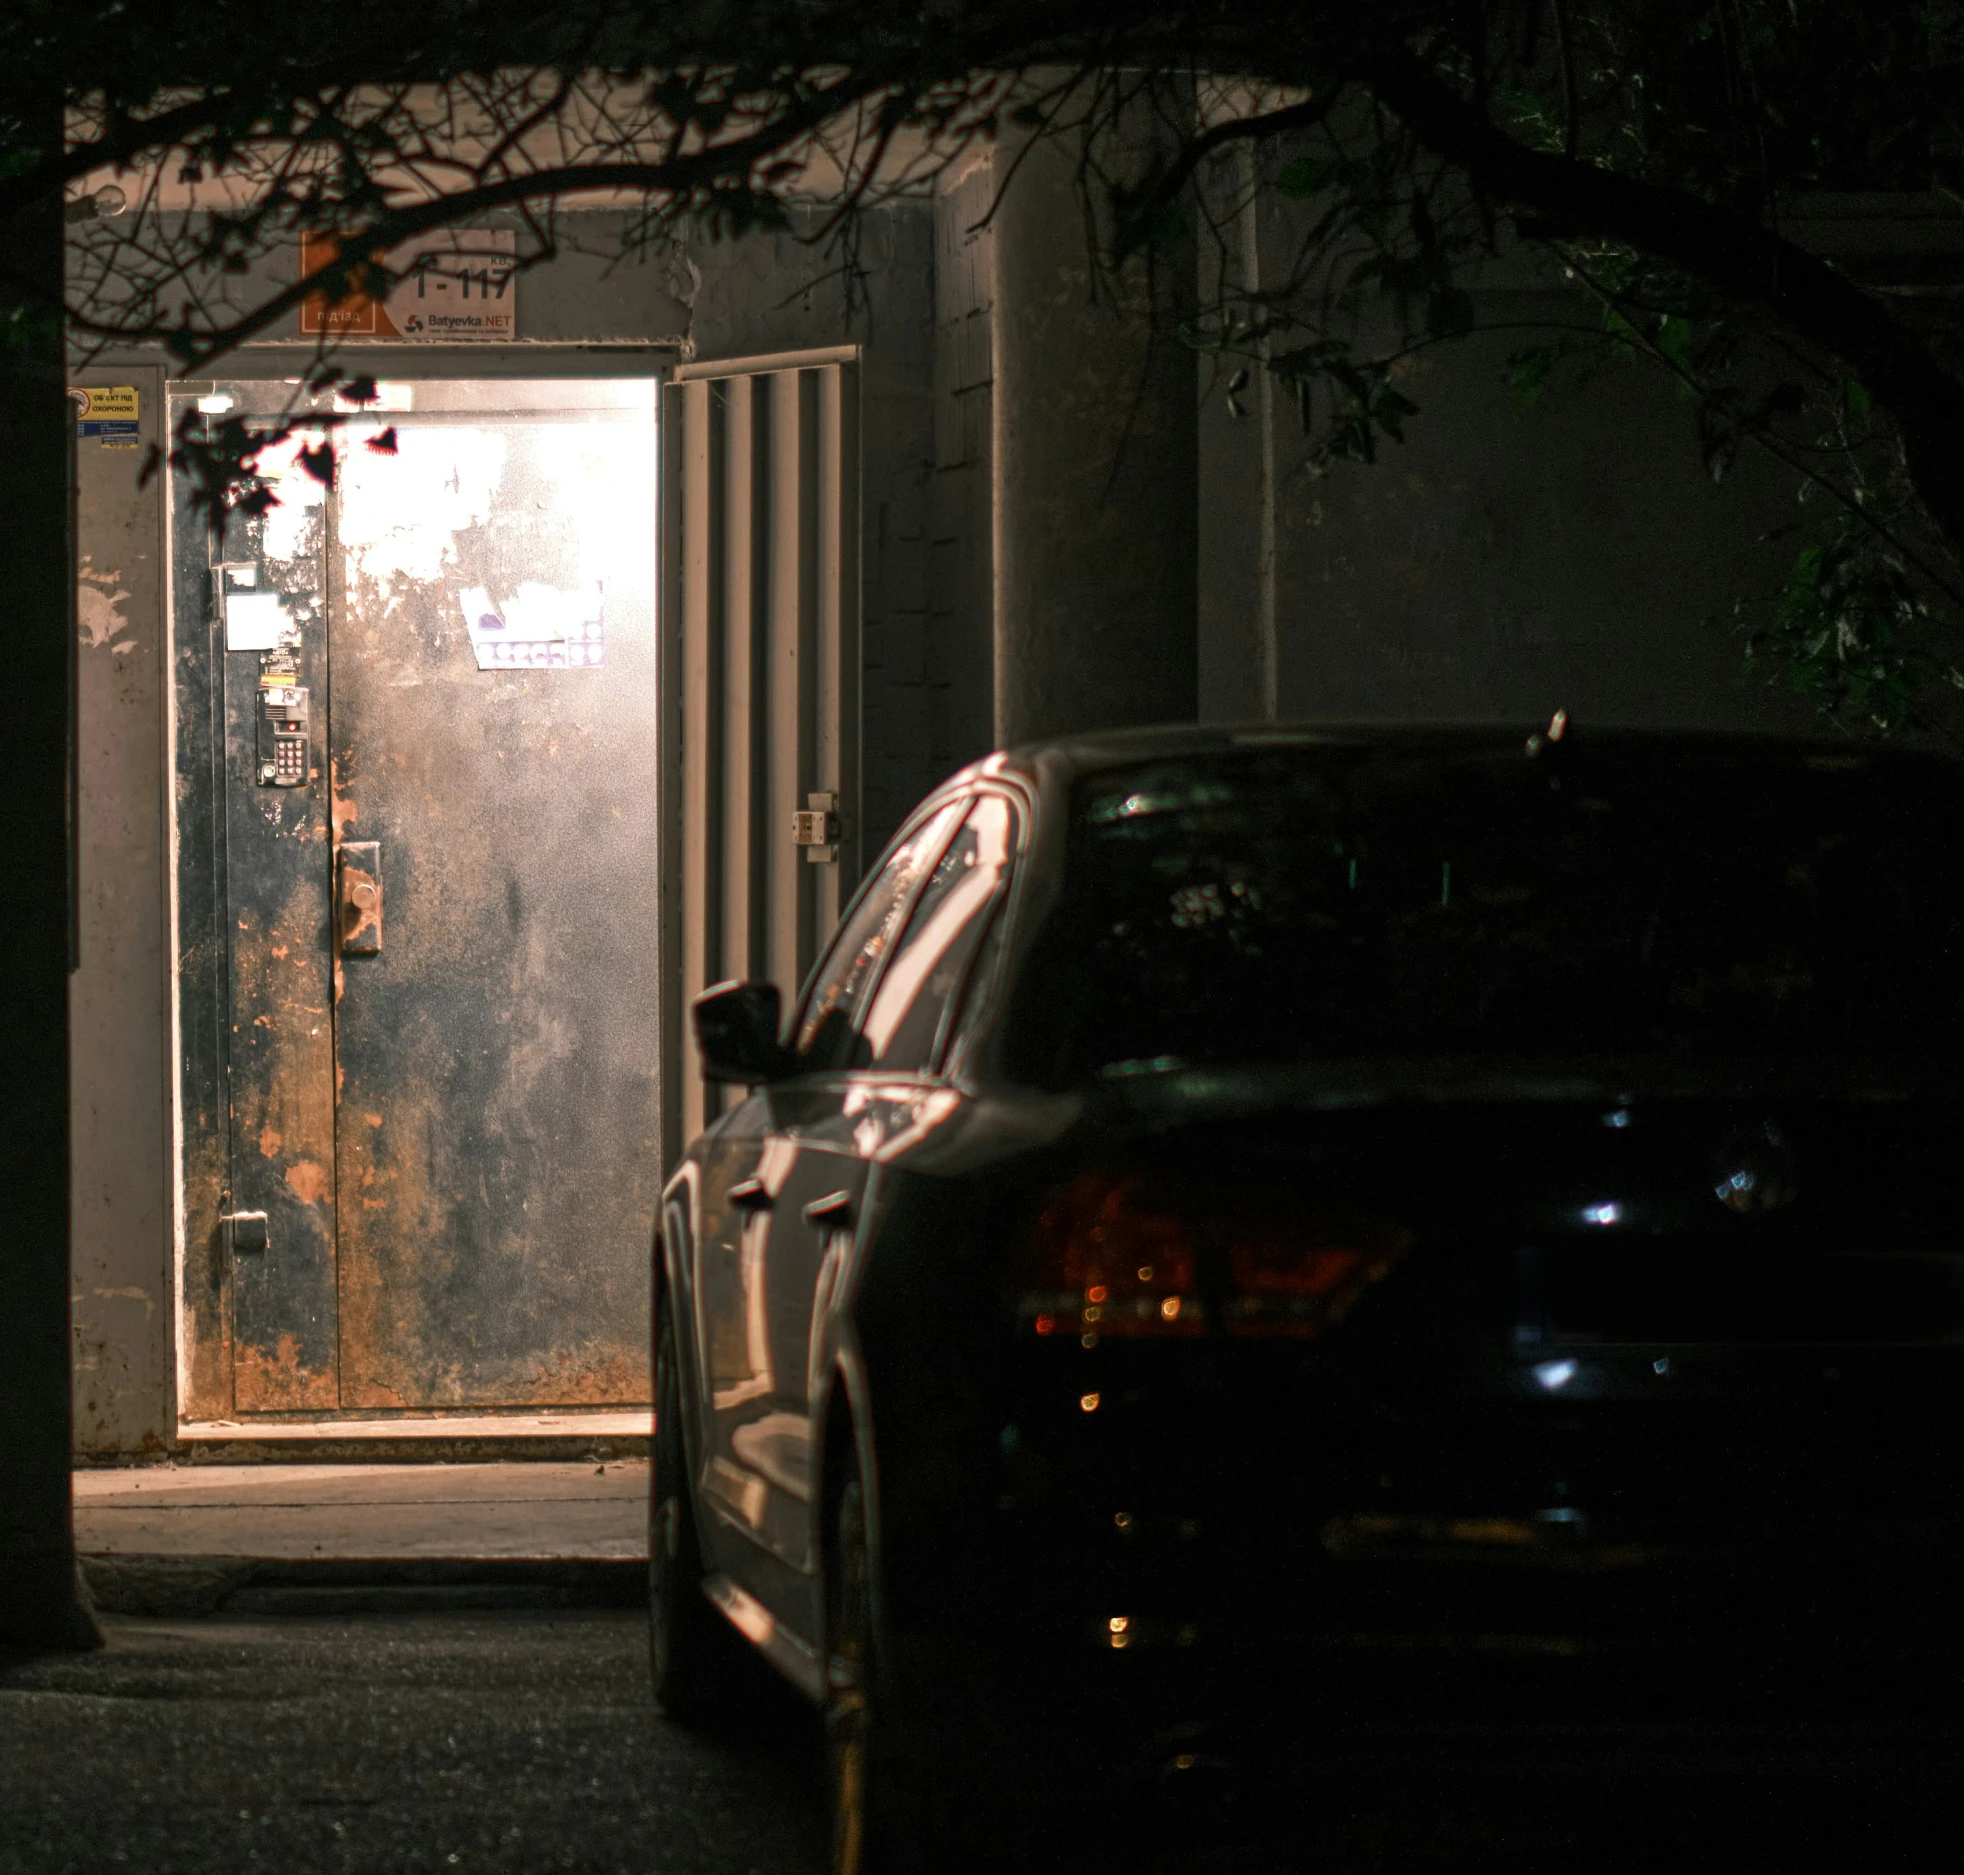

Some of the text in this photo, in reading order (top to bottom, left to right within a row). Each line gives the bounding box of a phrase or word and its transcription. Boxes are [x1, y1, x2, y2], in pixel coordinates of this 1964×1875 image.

[411, 267, 425, 299] 1
[456, 267, 512, 299] 117
[428, 314, 512, 329] Batyevka.NET
